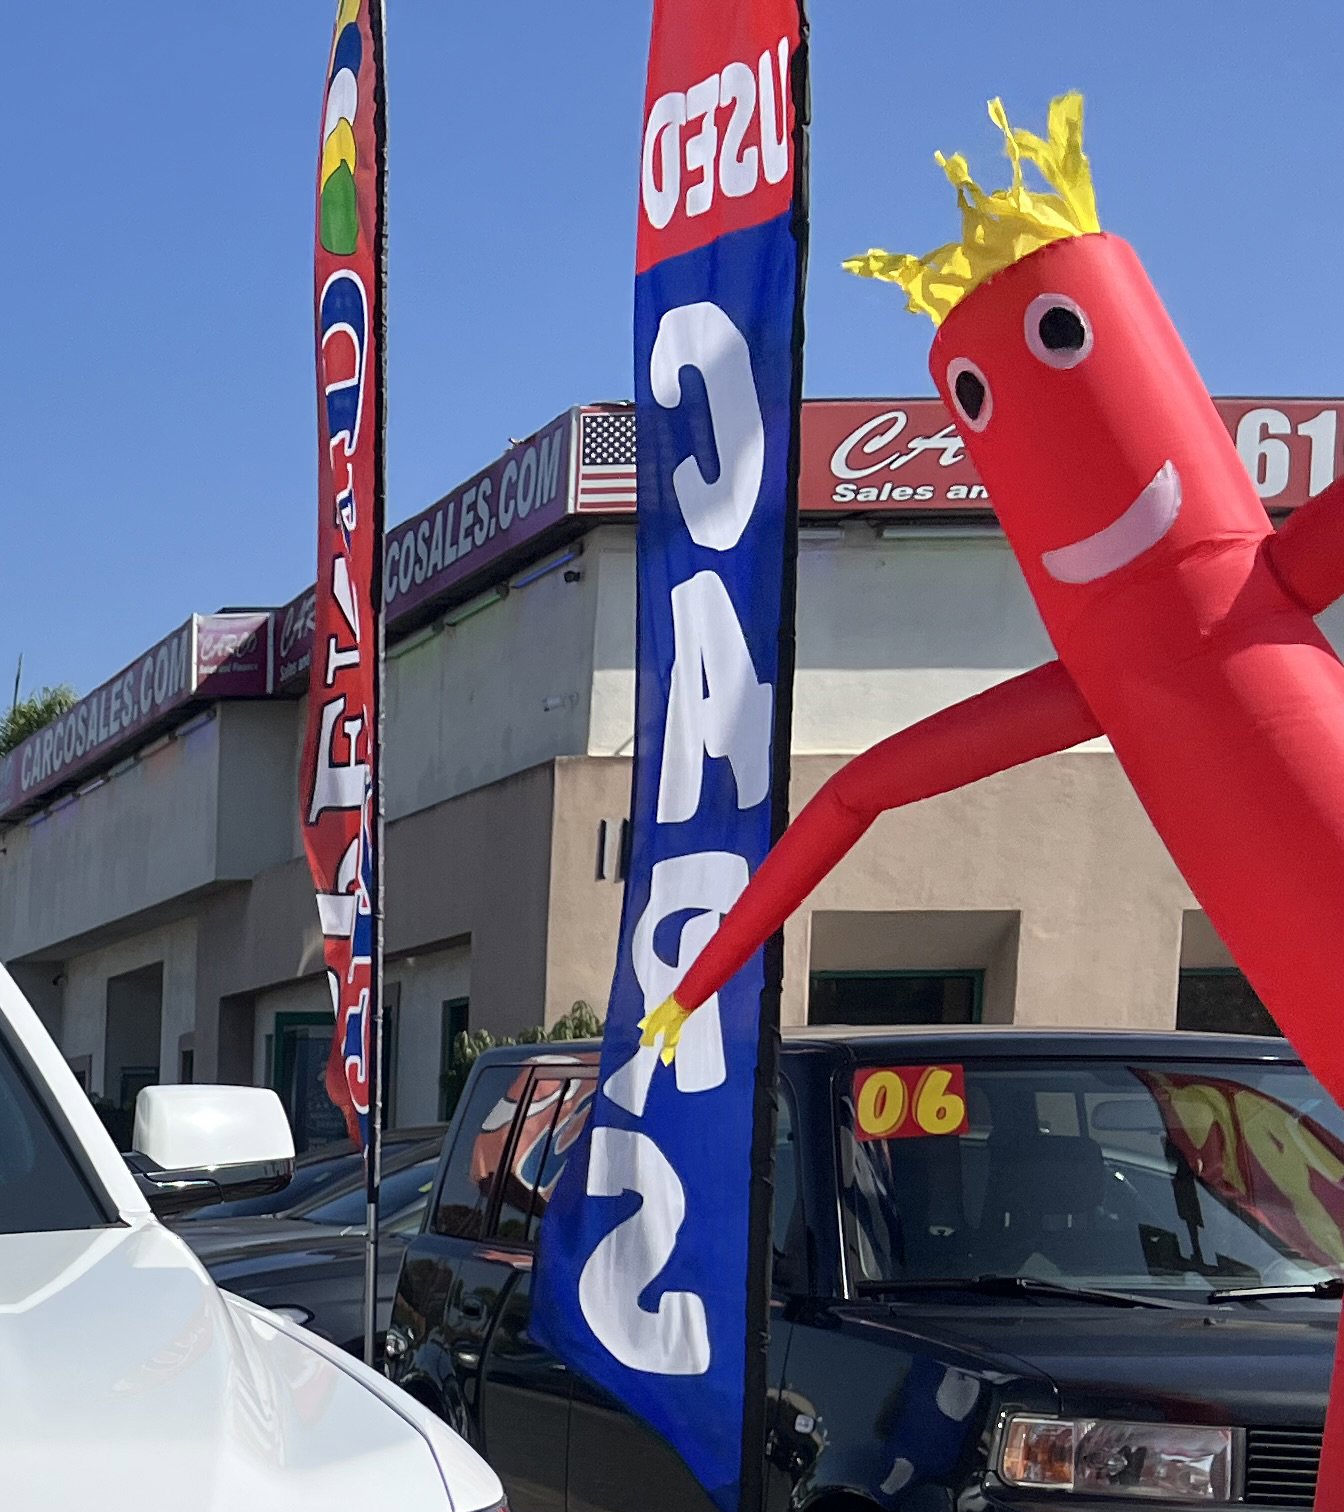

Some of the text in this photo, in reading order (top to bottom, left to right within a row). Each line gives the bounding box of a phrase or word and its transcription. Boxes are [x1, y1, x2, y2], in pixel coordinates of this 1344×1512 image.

[832, 482, 990, 502] Sales an
[1235, 407, 1337, 498] 61
[384, 426, 564, 603] COSALES.COM
[20, 627, 190, 793] CARCOSALES.COM
[857, 1067, 965, 1135] 06
